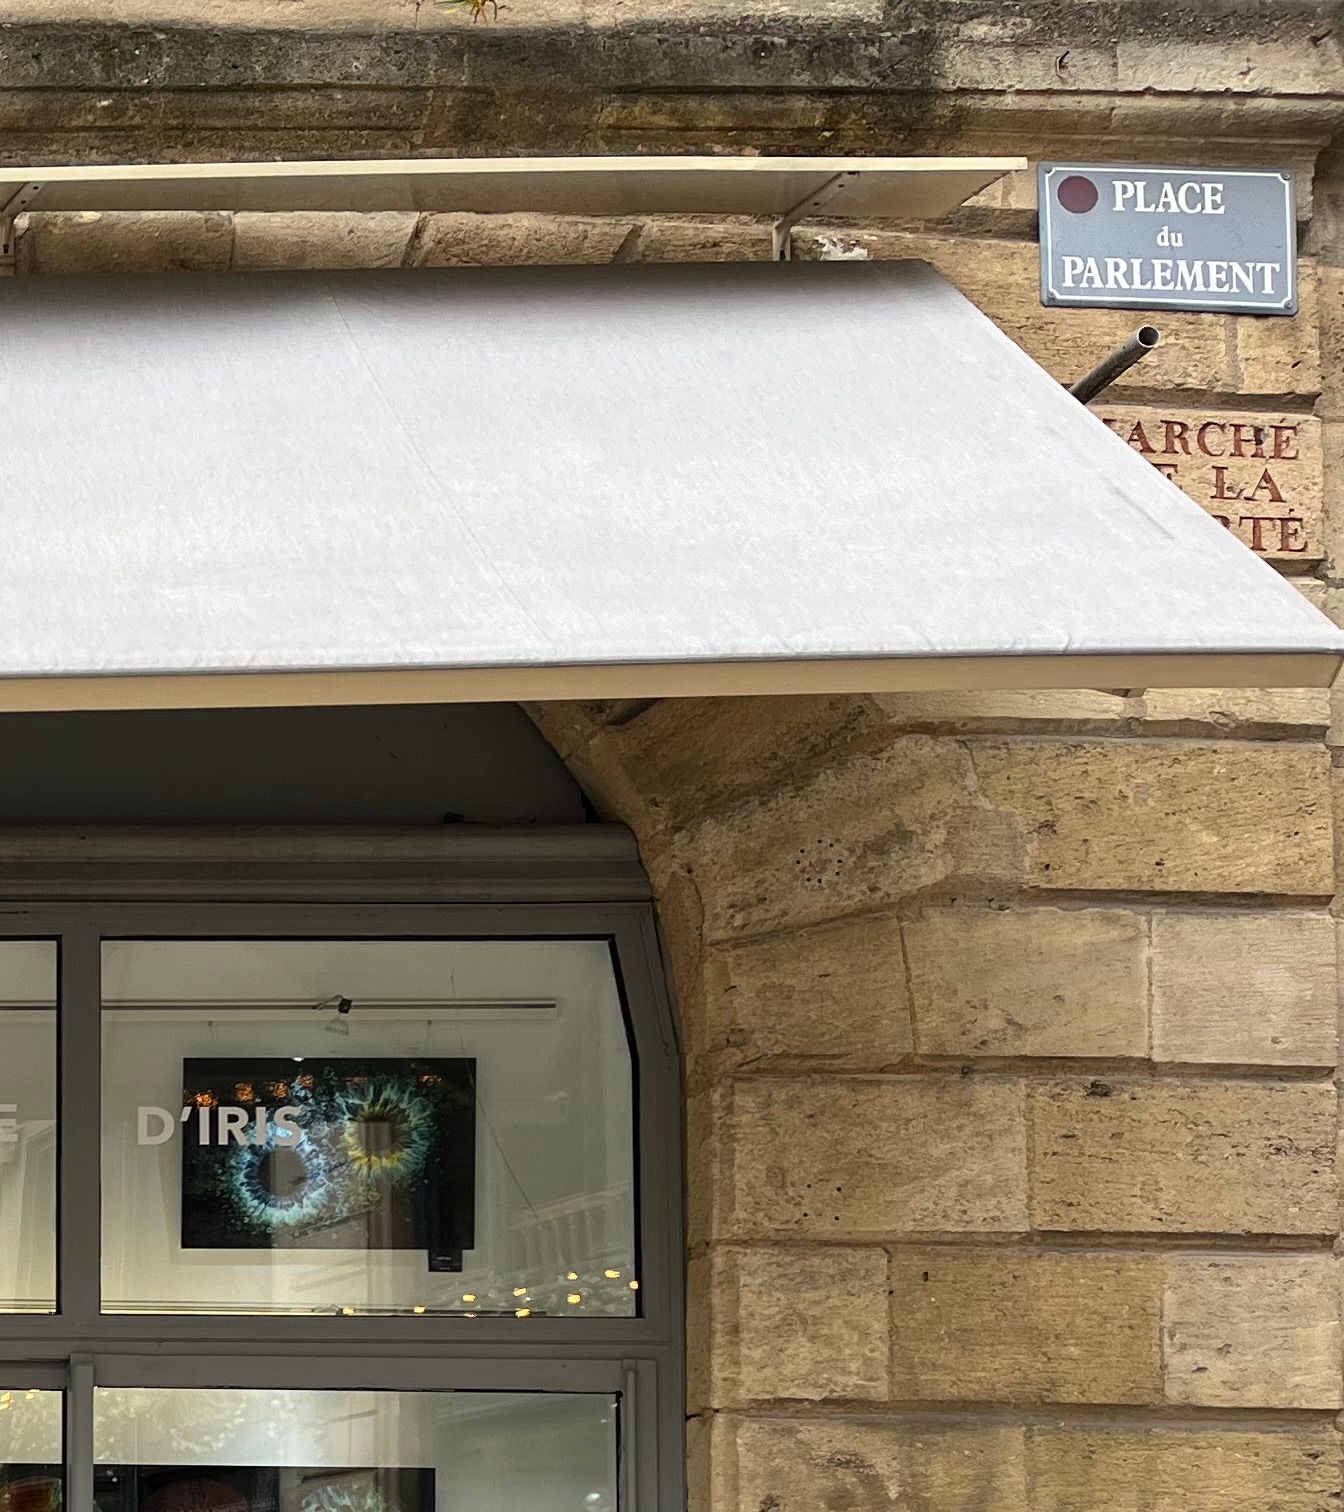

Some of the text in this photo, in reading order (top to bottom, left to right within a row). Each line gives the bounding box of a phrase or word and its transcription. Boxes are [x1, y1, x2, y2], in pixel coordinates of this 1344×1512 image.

[1111, 180, 1226, 215] PLACE
[1156, 226, 1184, 249] du
[1061, 256, 1281, 295] PARLEMENT
[1102, 416, 1300, 461] ARCHÉ
[1210, 466, 1288, 503] LA
[135, 1104, 306, 1147] D'IRIS
